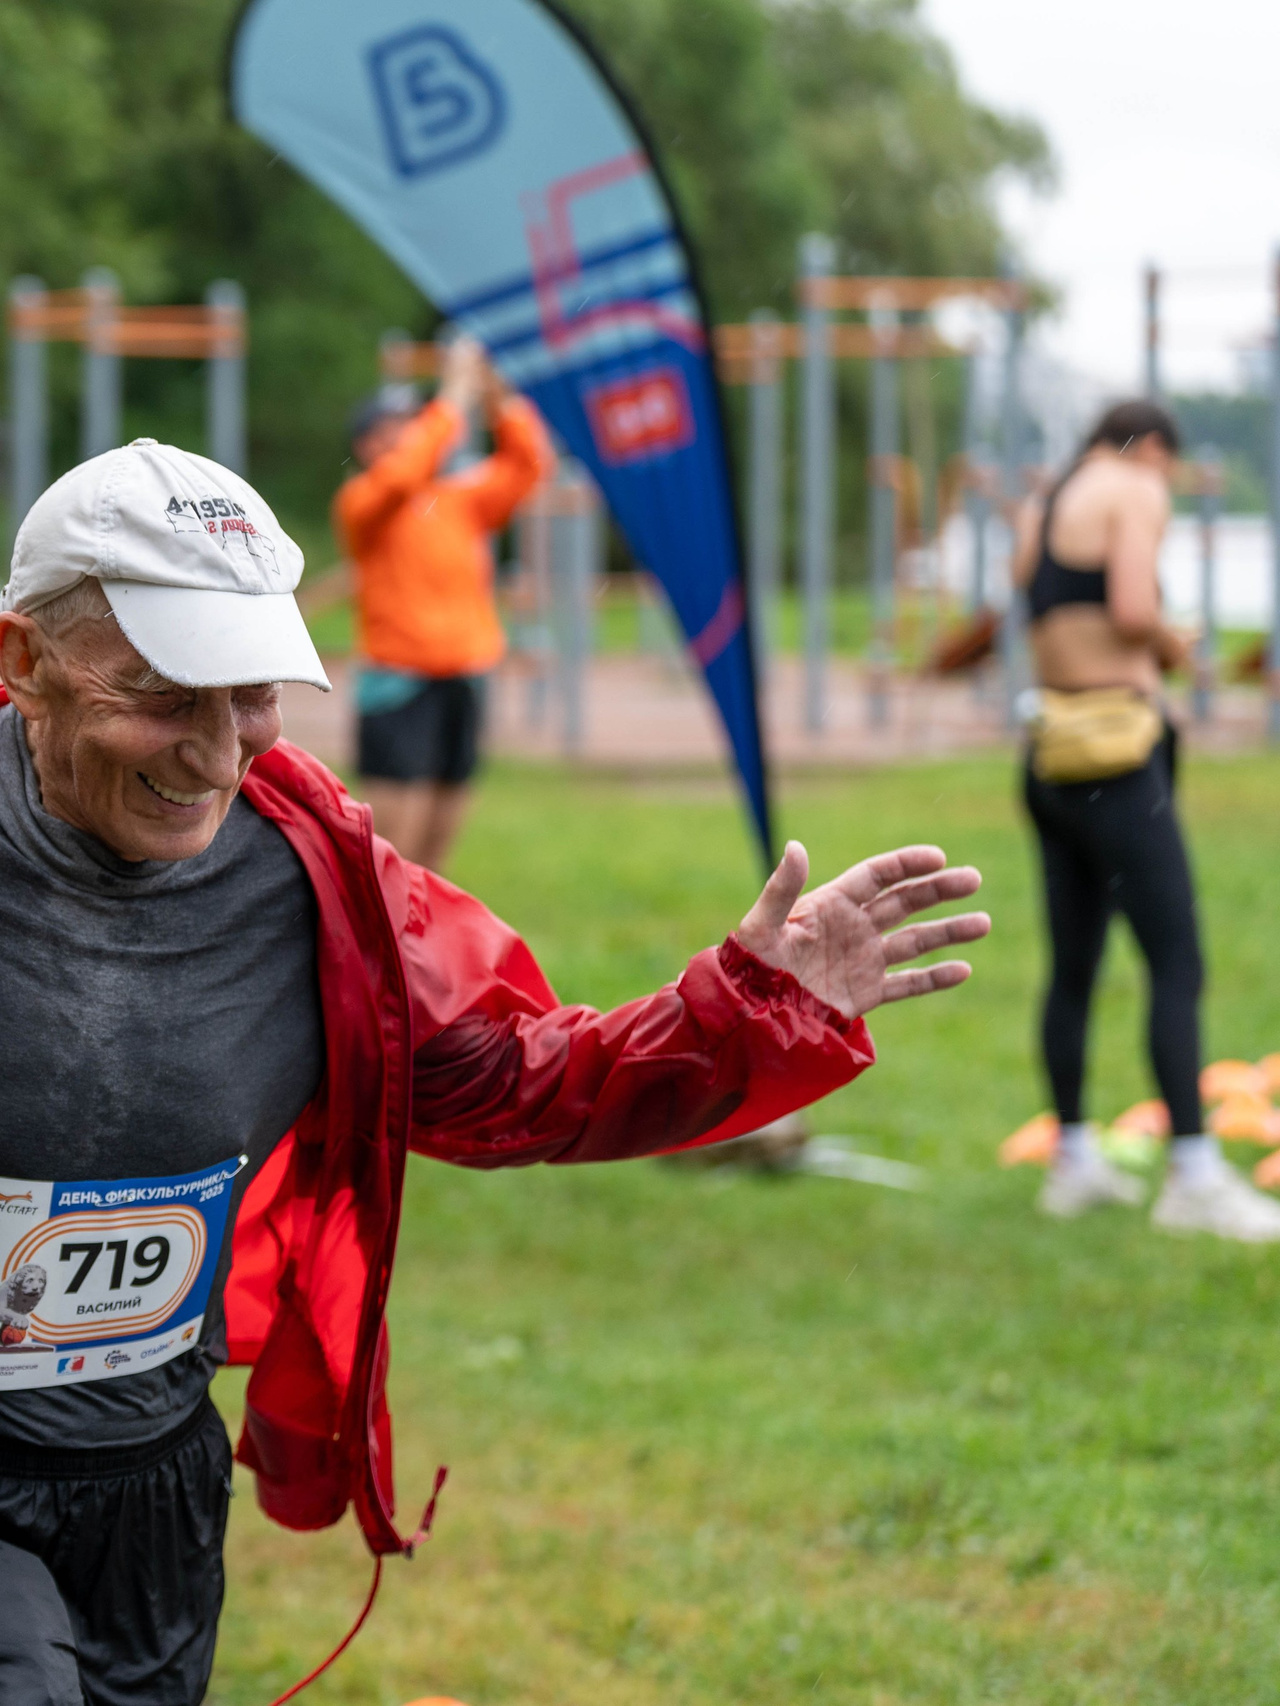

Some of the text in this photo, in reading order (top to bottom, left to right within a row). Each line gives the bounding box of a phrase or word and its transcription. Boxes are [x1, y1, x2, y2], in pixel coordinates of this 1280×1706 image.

[58, 1190, 102, 1207] ДЕНЬ
[198, 1182, 224, 1203] 2025
[6, 1204, 39, 1216] СТАРТ
[58, 1234, 171, 1295] 719
[75, 1296, 142, 1316] ВАСИЛИЙ
